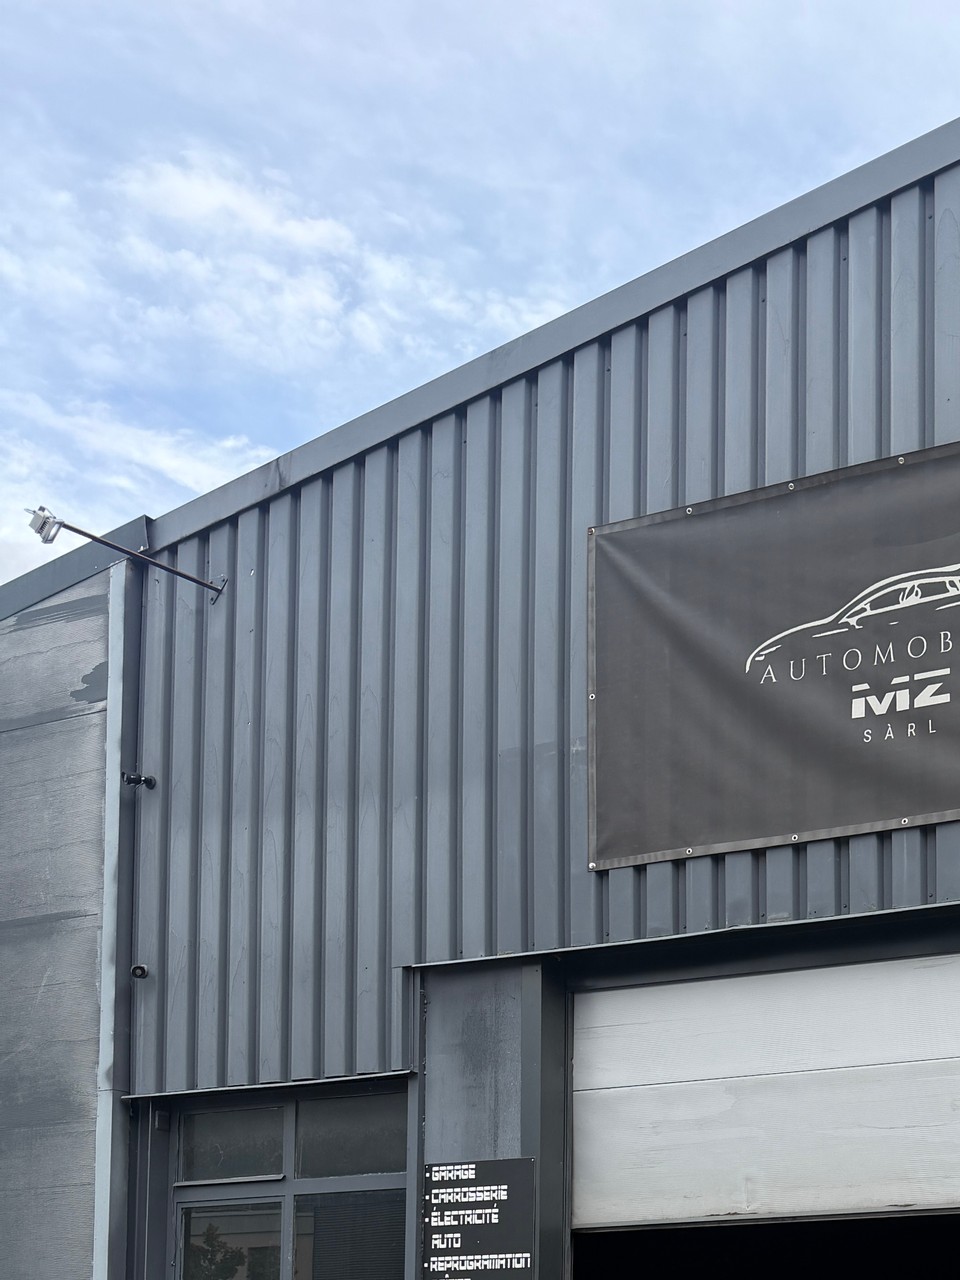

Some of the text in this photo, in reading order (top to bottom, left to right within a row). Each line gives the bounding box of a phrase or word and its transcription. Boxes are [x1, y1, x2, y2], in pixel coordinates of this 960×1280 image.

[851, 667, 951, 719] MZ
[862, 719, 937, 743] SÀRL
[431, 1164, 476, 1181] GARAGE
[431, 1185, 508, 1204] CARROSSERIE
[430, 1203, 500, 1227] ÉLECTRICITÉ
[431, 1233, 461, 1249] AUTO
[429, 1252, 531, 1272] REPROGRAMATION
